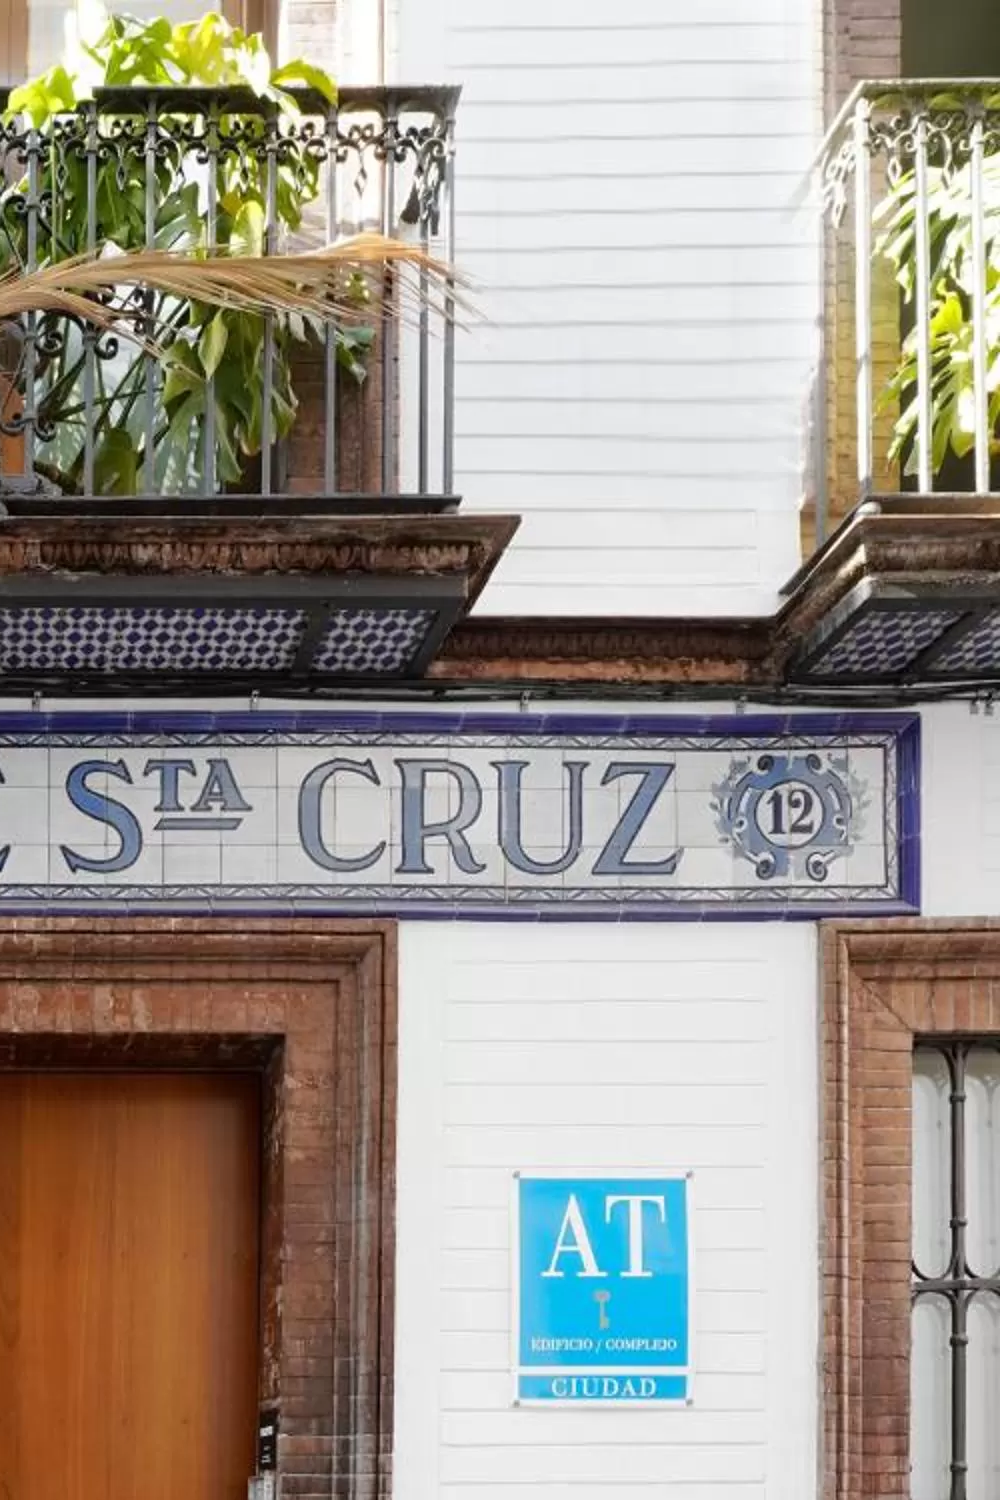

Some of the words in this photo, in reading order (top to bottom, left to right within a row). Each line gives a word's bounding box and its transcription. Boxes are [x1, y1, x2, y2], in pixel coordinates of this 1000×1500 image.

[298, 757, 685, 876] CRUZ
[766, 789, 815, 835] 12
[540, 1192, 665, 1278] AT
[531, 1336, 593, 1352] EDIFICIO
[605, 1336, 678, 1352] COMPLEJO
[551, 1377, 657, 1397] CIUDAD
